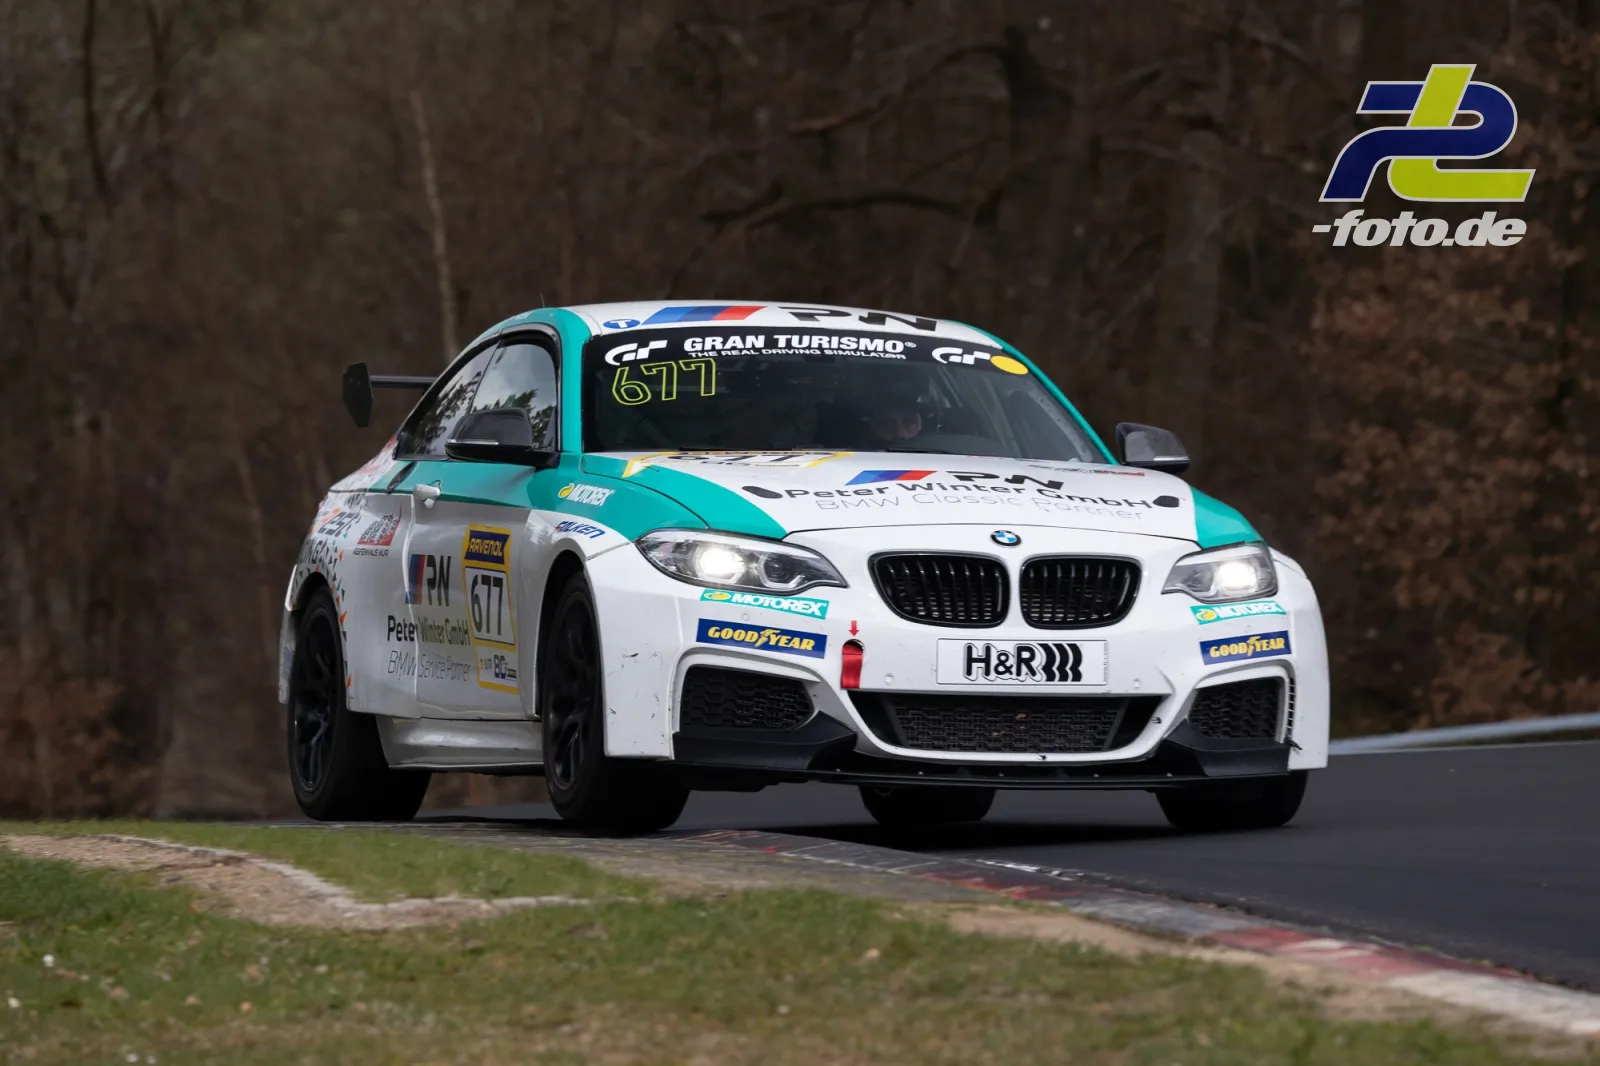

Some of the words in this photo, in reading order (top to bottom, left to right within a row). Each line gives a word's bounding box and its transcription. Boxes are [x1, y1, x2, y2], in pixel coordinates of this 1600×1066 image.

[777, 306, 937, 332] PN
[683, 335, 765, 352] GRAN
[762, 348, 821, 356] DRIVING
[824, 349, 907, 360] SIMULATOR
[611, 357, 717, 406] 677
[946, 470, 1064, 490] PN
[567, 483, 616, 507] MOTOREX
[784, 486, 889, 499] Peter
[896, 482, 1026, 495] Winter
[1036, 488, 1153, 509] GmbH
[816, 496, 900, 510] BMW
[912, 492, 1023, 506] Classic
[1032, 497, 1143, 520] Partner
[468, 538, 503, 557] RAVENOL
[425, 554, 452, 607] PN
[470, 574, 504, 636] 677
[731, 593, 824, 617] MOTOREX
[1212, 602, 1285, 619] MOTOREX
[387, 614, 419, 643] Peter
[419, 616, 445, 646] Winter
[445, 618, 471, 646] GmbH
[707, 626, 816, 651] GOODYEAR
[1209, 636, 1286, 658] GOODYEAR
[387, 650, 416, 677] BMW
[419, 653, 445, 680] Service
[446, 656, 471, 682] Partner
[964, 643, 1041, 682] H&R
